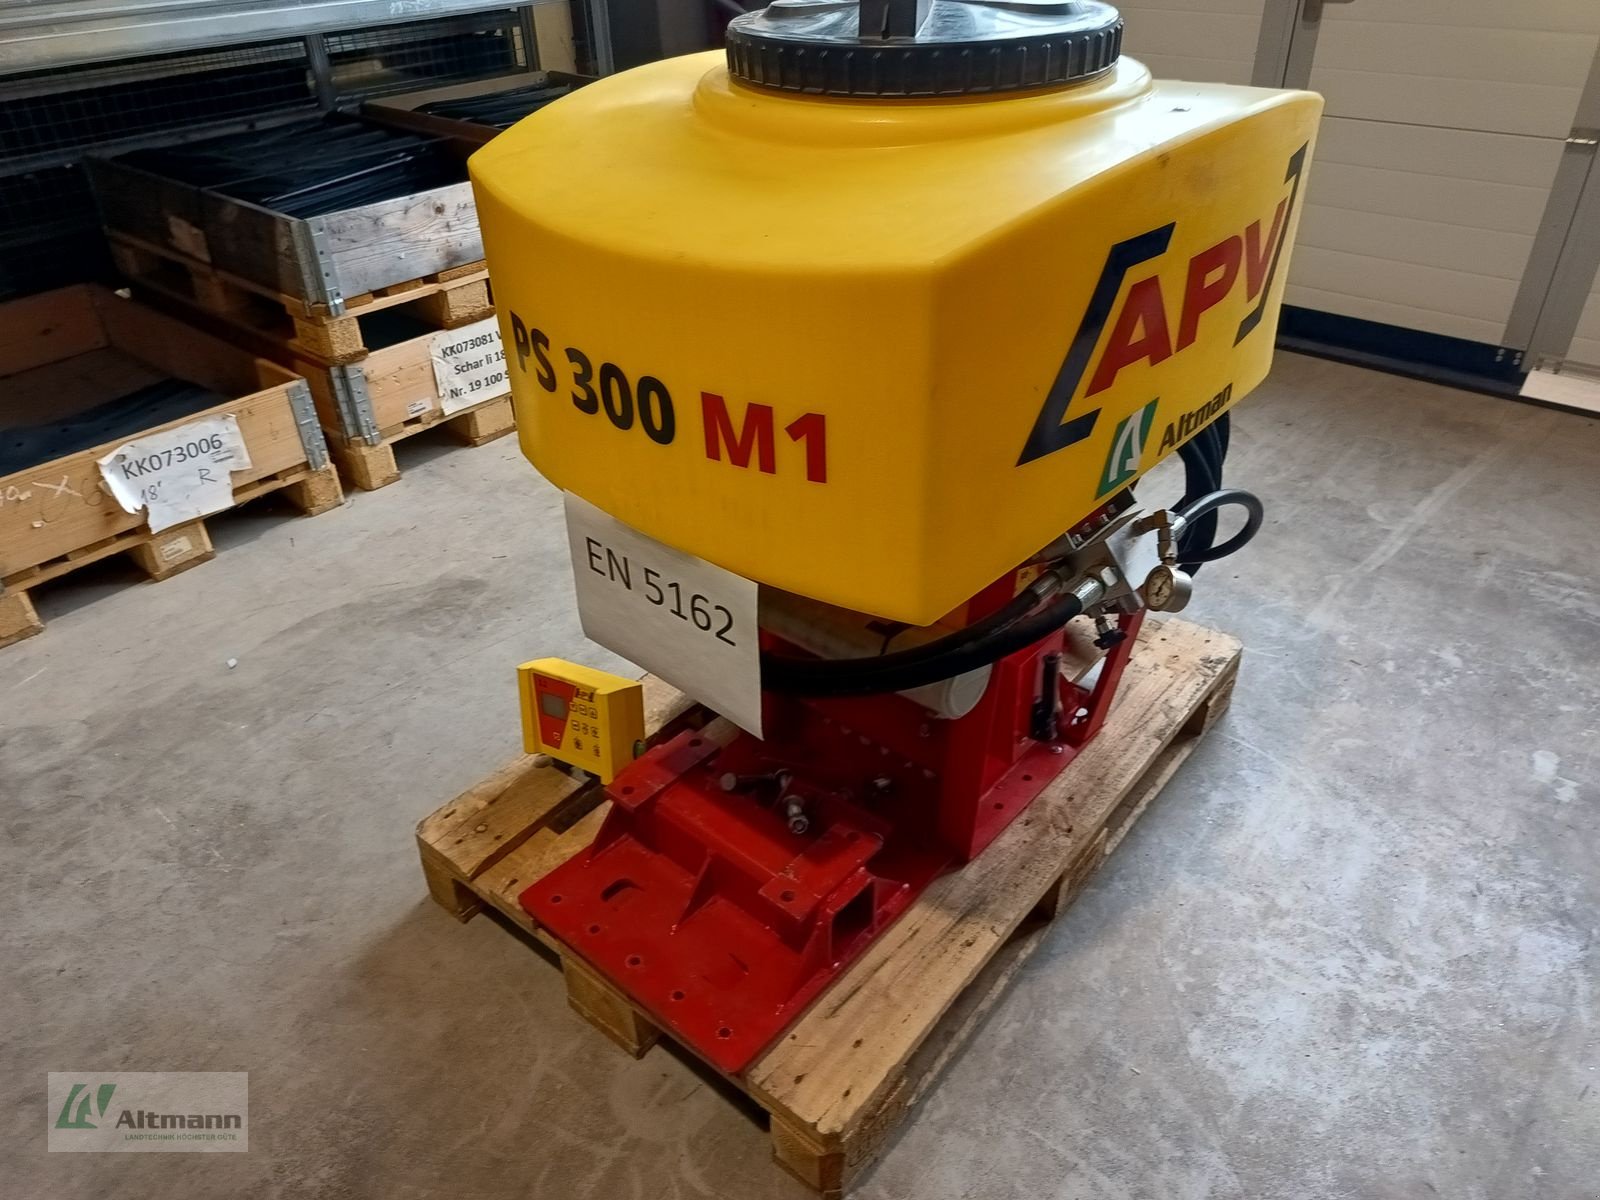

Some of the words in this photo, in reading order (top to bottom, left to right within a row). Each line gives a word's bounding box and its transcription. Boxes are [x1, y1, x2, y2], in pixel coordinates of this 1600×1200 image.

[1084, 196, 1288, 398] APV
[441, 333, 494, 358] KK073081
[454, 360, 483, 375] Schar
[449, 387, 467, 399] Nr.
[468, 379, 482, 393] 19
[484, 372, 503, 387] 100
[509, 310, 557, 393] PS
[565, 347, 676, 445] 300
[700, 390, 827, 484] M1
[121, 433, 223, 480] KK073006
[585, 536, 632, 591] EN
[643, 566, 737, 647] 5162
